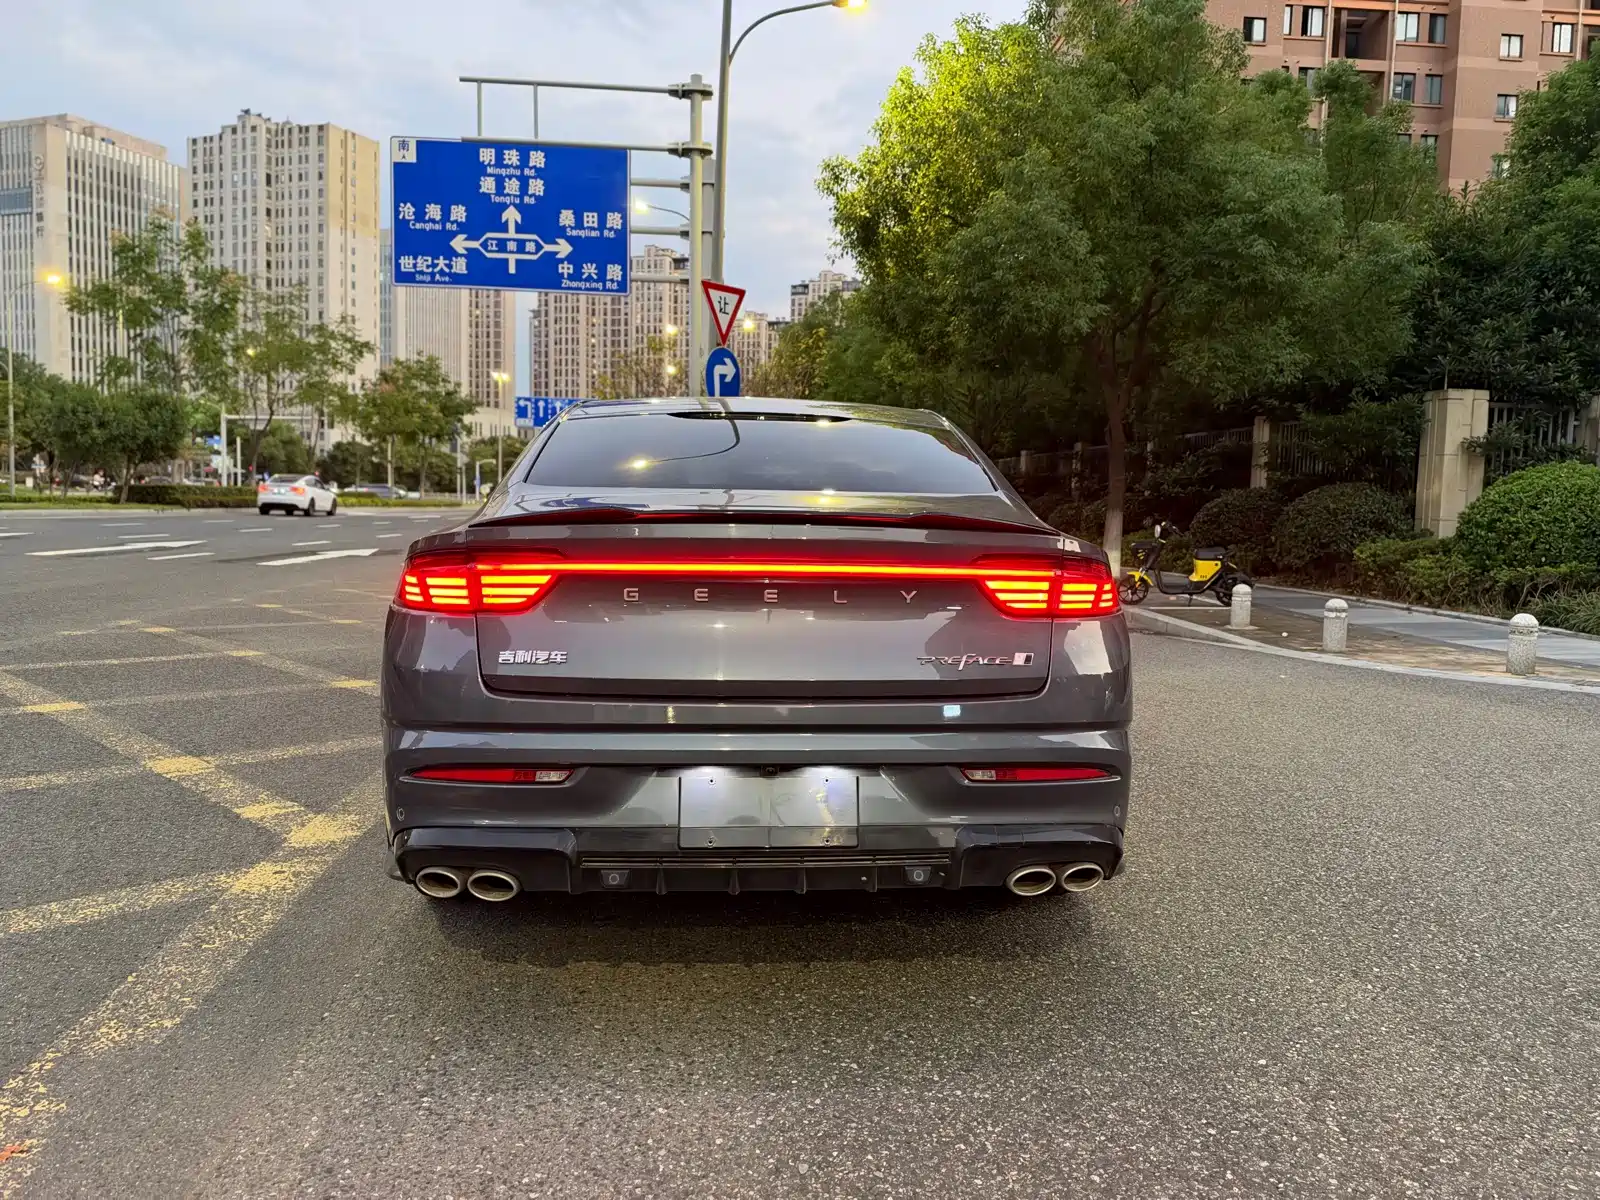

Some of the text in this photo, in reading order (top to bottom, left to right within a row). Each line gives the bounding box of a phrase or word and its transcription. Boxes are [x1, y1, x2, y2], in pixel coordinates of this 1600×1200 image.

[397, 138, 410, 152] 南
[479, 148, 546, 168] 明珠路
[486, 166, 521, 177] Mingzhu
[479, 176, 545, 196] 通途路
[490, 194, 520, 205] Tongtu
[398, 202, 467, 222] 沧海路
[409, 221, 442, 231] Canghai
[559, 209, 623, 230] 桑田路
[566, 227, 600, 238] Sangtian
[487, 239, 537, 253] 江南路
[398, 255, 468, 274] 世纪大道
[558, 260, 623, 281] 中兴路
[561, 279, 603, 290] Zhongxing
[718, 296, 730, 315] 让
[623, 588, 917, 603] GEELY
[498, 650, 567, 664] 吉利汽车
